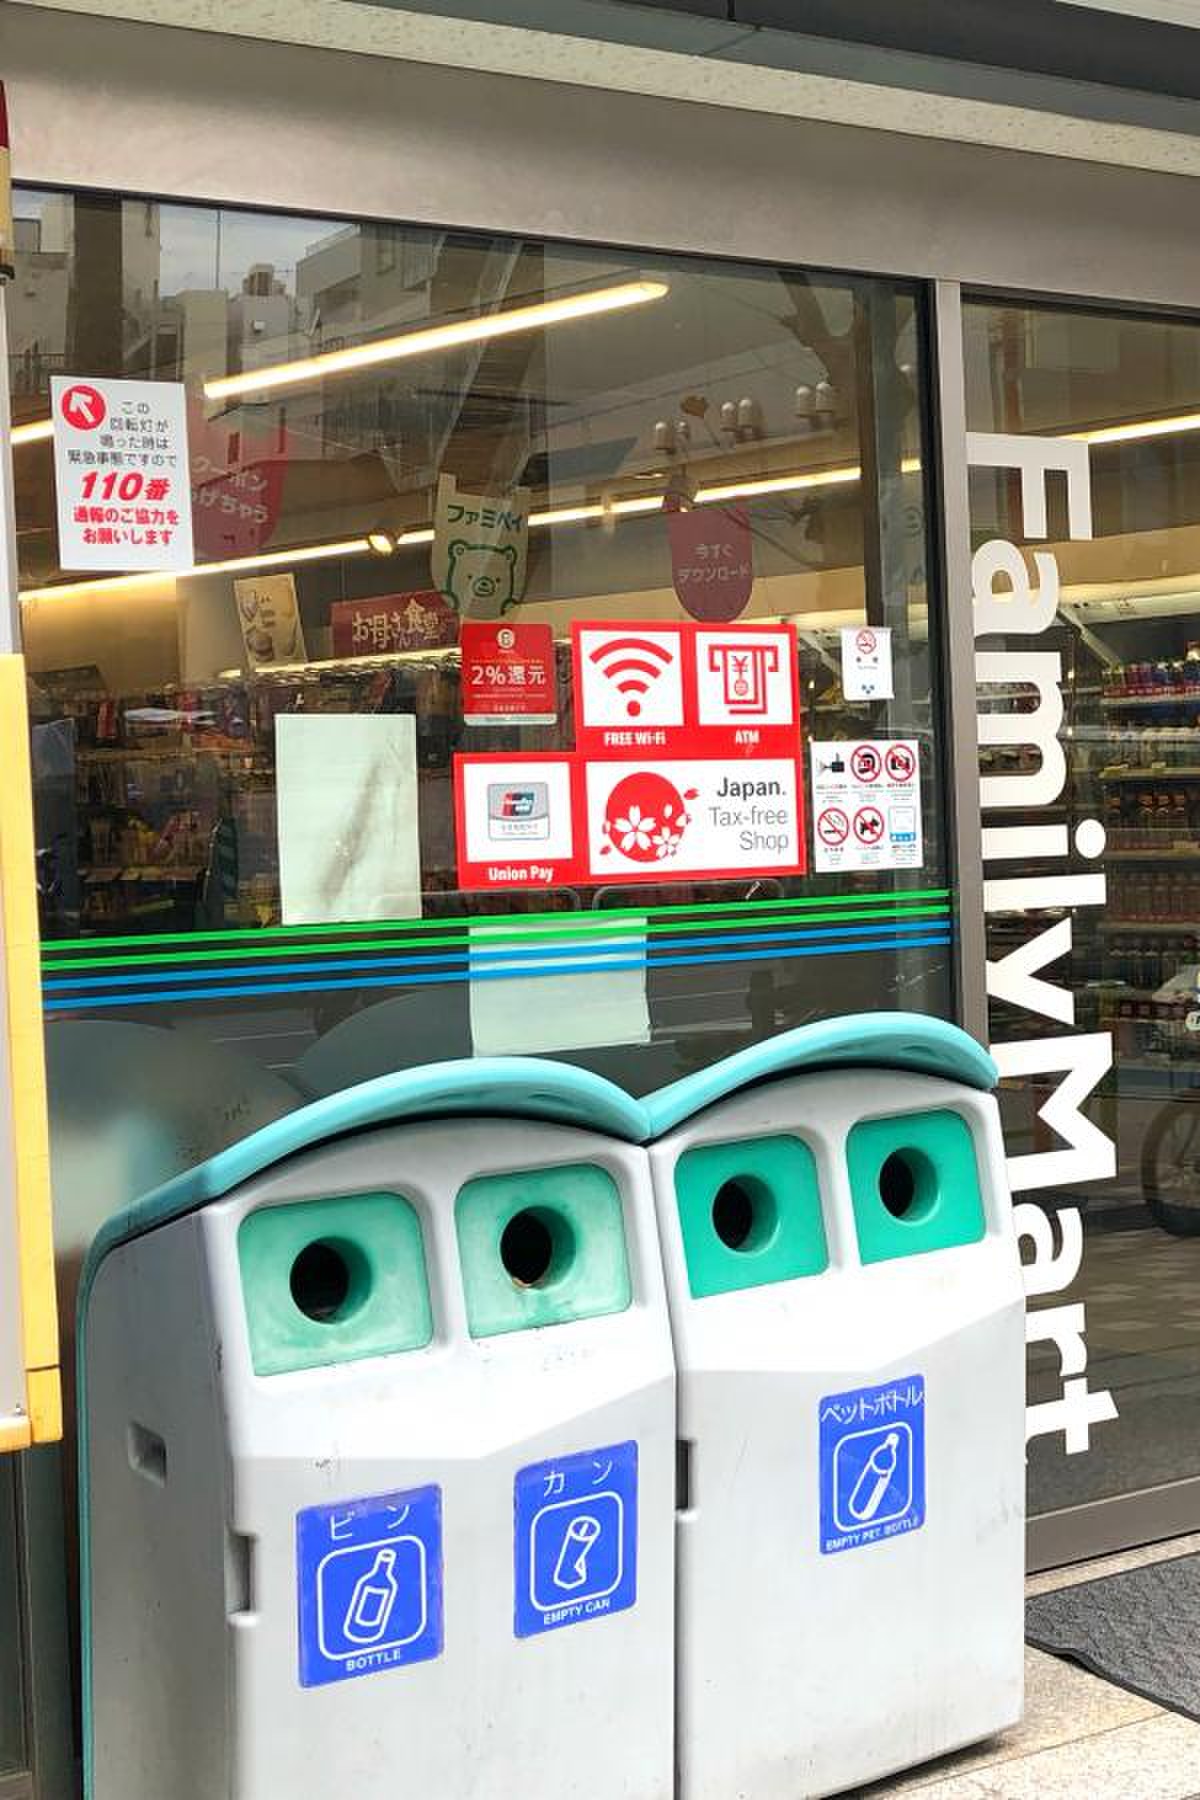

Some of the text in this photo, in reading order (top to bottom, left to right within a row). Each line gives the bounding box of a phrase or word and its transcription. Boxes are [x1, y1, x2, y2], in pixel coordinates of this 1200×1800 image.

[121, 401, 150, 415] この
[67, 449, 177, 467] 緊急事態ですので
[80, 470, 171, 501] 110番
[73, 504, 180, 526] 通報のご協力を
[447, 504, 523, 532] ファミペイ
[82, 527, 175, 546] お願いします
[471, 665, 547, 686] 2%還元
[604, 730, 667, 747] FREE Wi-Fi
[735, 729, 760, 745] ATM
[717, 777, 787, 800] Japan.
[708, 805, 789, 827] Tax-free
[738, 830, 790, 854] Shop
[488, 866, 554, 883] Union Pay
[966, 431, 1120, 1456] FamilyMart
[821, 1384, 925, 1425] ペットボトル
[543, 1459, 613, 1497] カン
[330, 1503, 409, 1541] ビン
[825, 1533, 862, 1552] EMPTY
[883, 1516, 919, 1535] BOTTLE
[543, 1597, 612, 1625] EMPTY CAN
[345, 1648, 401, 1672] BOTTLE
